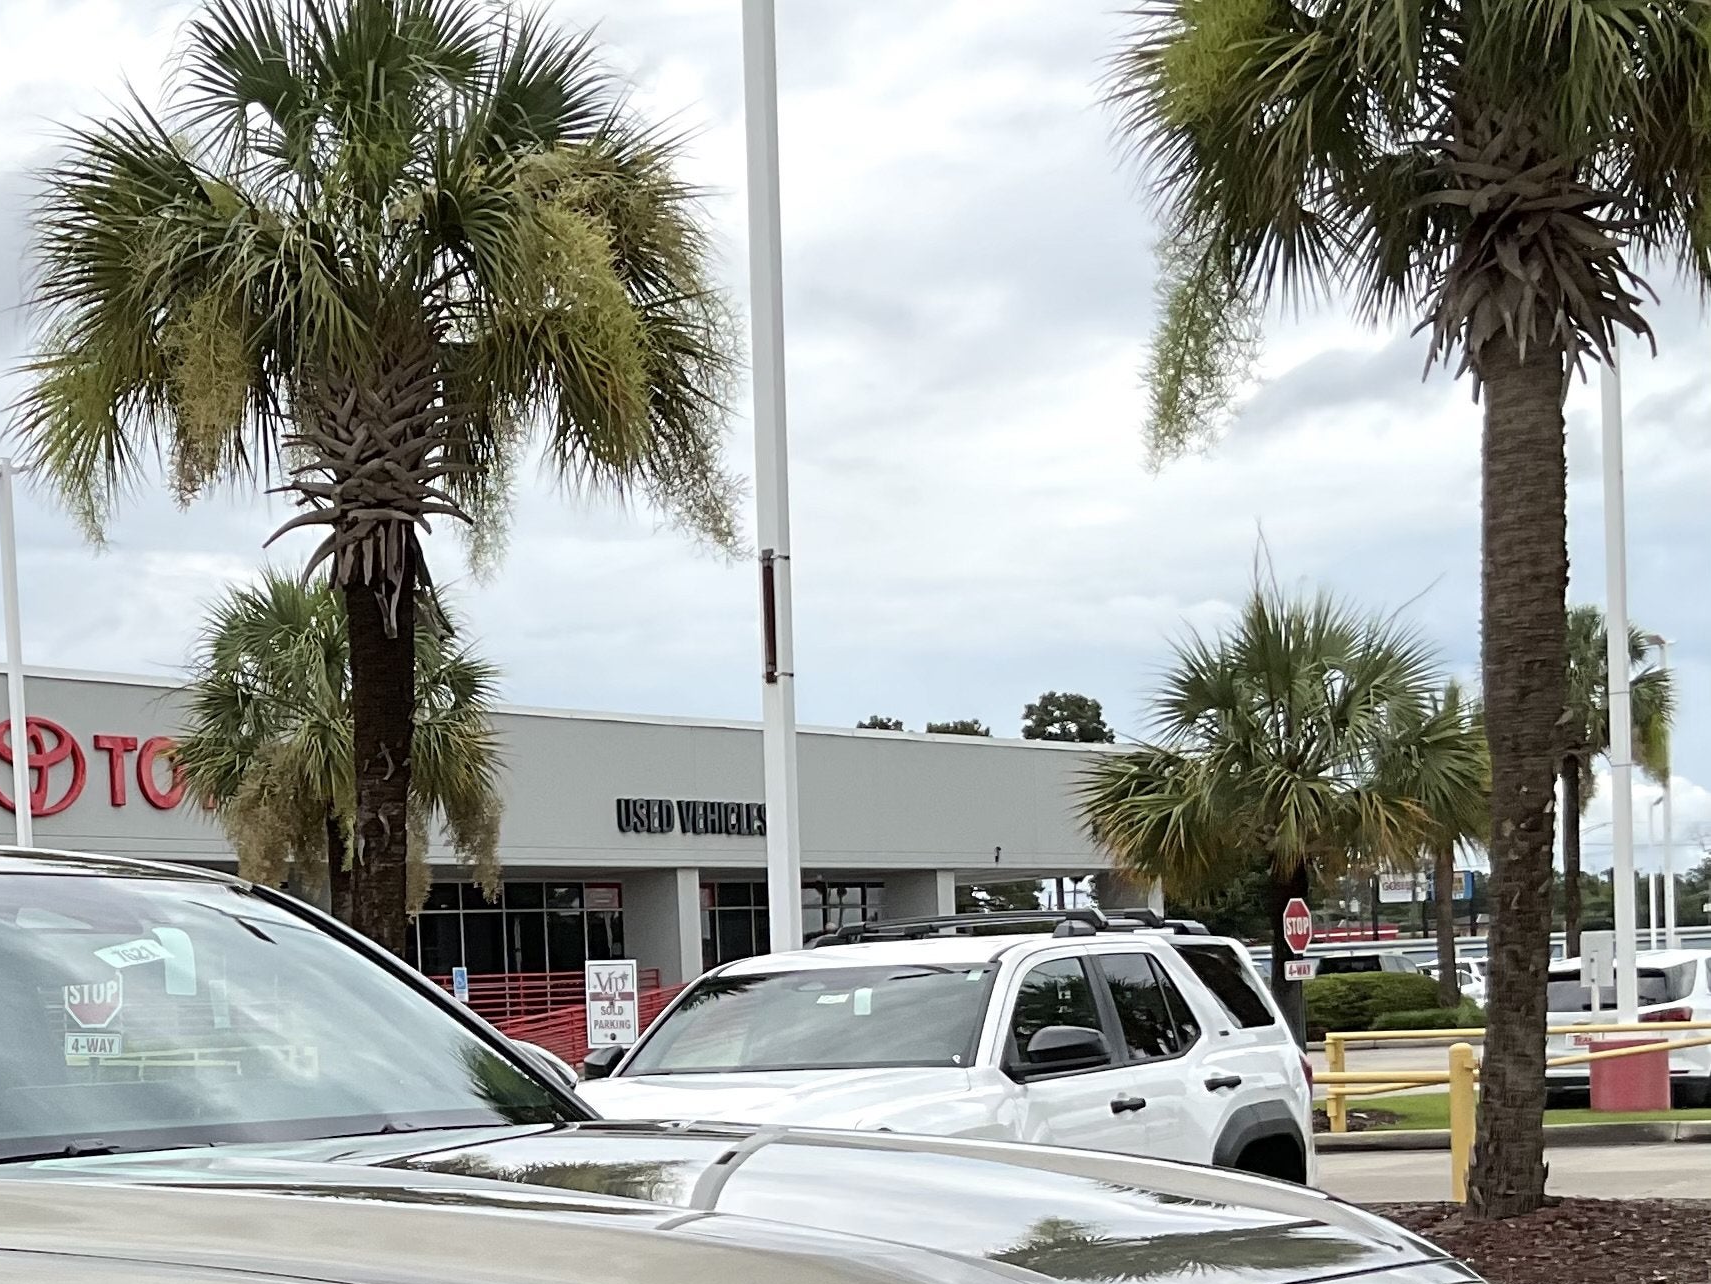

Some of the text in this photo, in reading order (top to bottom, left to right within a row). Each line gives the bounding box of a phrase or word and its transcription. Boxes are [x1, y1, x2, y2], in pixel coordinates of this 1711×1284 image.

[616, 798, 767, 836] USED VEHICLES
[1286, 916, 1309, 936] STOP
[1288, 964, 1311, 977] 4-WAY
[69, 980, 118, 1005] STOP
[600, 1005, 625, 1016] SOLD
[593, 1019, 632, 1030] PARKING
[71, 1038, 116, 1053] 4-WAY
